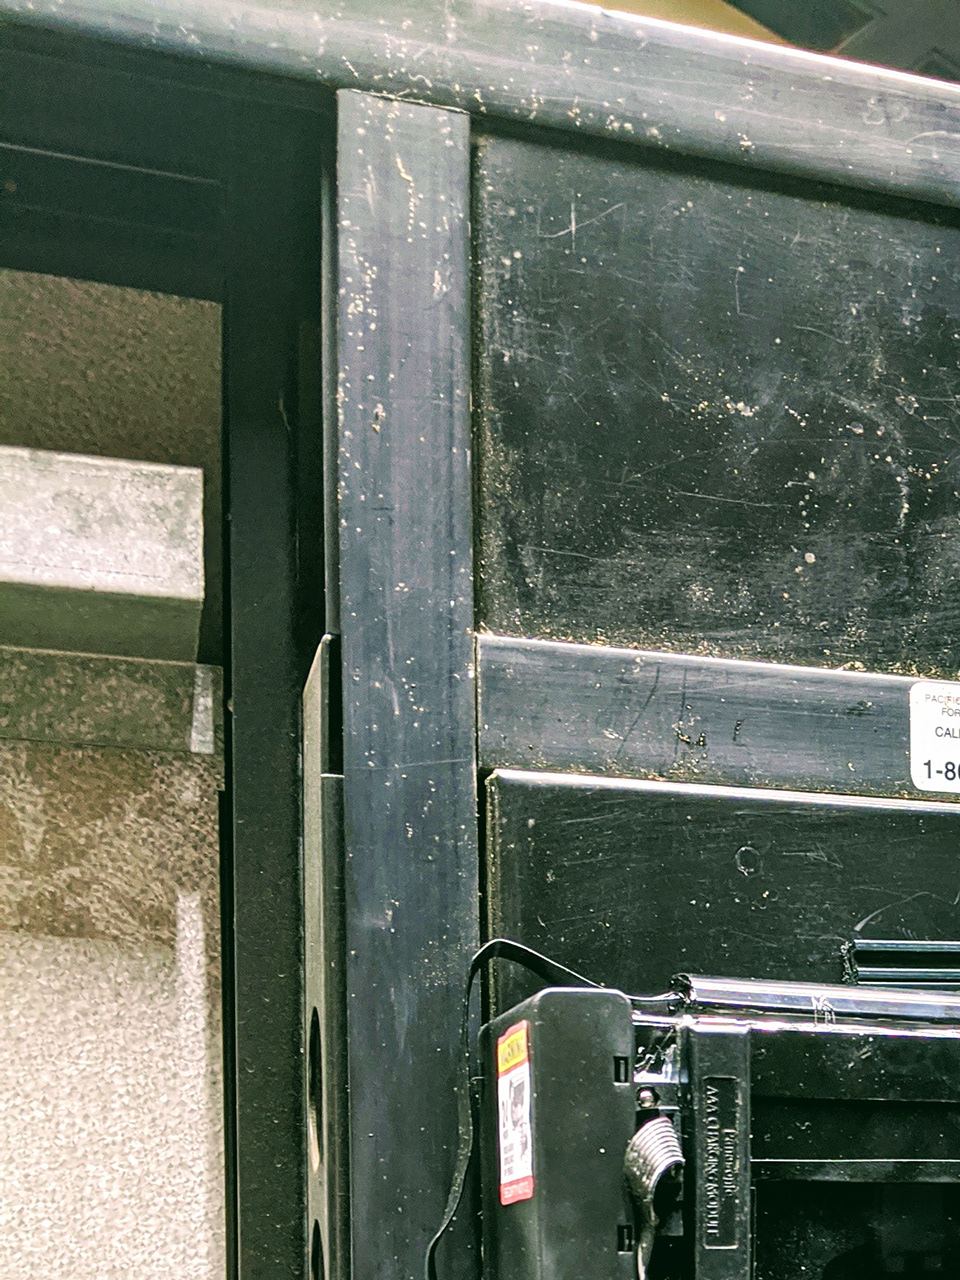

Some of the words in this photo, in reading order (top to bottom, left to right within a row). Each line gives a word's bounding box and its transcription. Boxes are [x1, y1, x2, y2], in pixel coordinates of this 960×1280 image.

[942, 708, 960, 717] FOR
[706, 1086, 719, 1112] AAA
[706, 1117, 720, 1180] CHARGING
